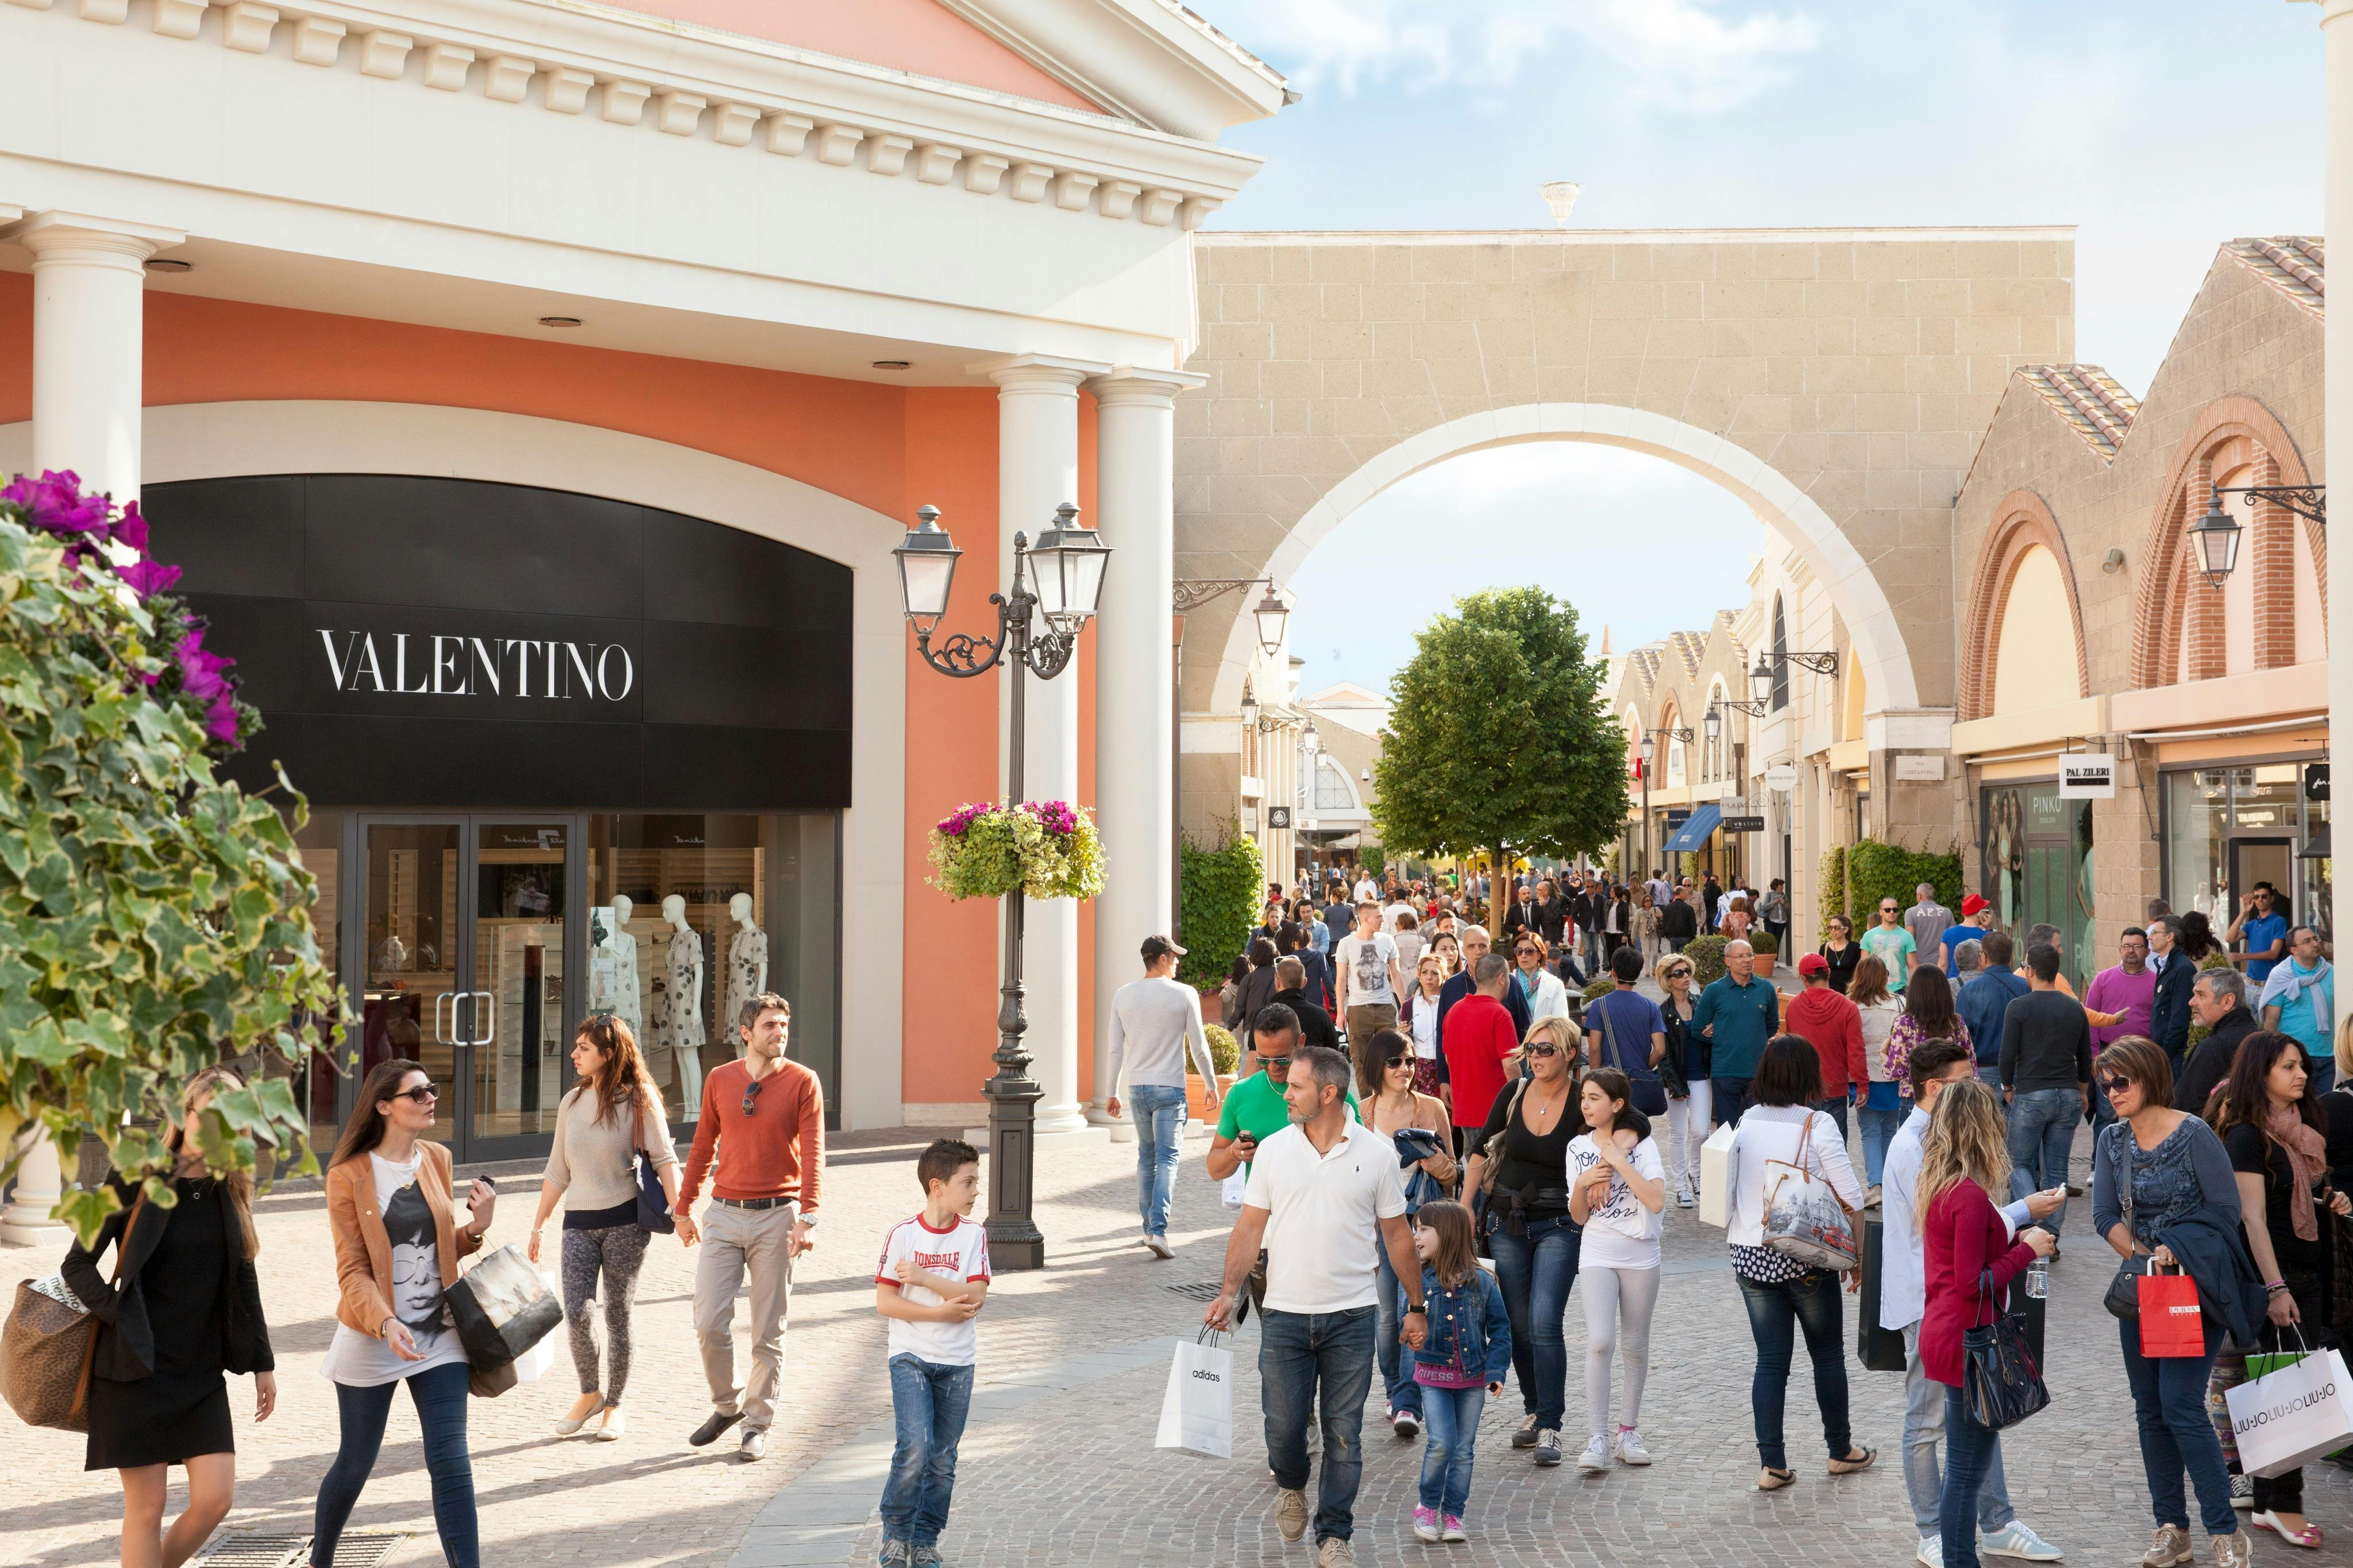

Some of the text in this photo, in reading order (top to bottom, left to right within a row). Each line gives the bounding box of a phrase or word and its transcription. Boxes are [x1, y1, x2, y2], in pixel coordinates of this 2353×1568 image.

[315, 629, 632, 701] VALENTINO
[2066, 768, 2109, 777] PAL ZILERI
[2033, 795, 2062, 813] PINKO
[1916, 907, 1945, 917] A&F
[914, 1250, 960, 1267] LONSDALE
[1193, 1369, 1220, 1382] adidas
[1418, 1369, 1454, 1382] GUESS
